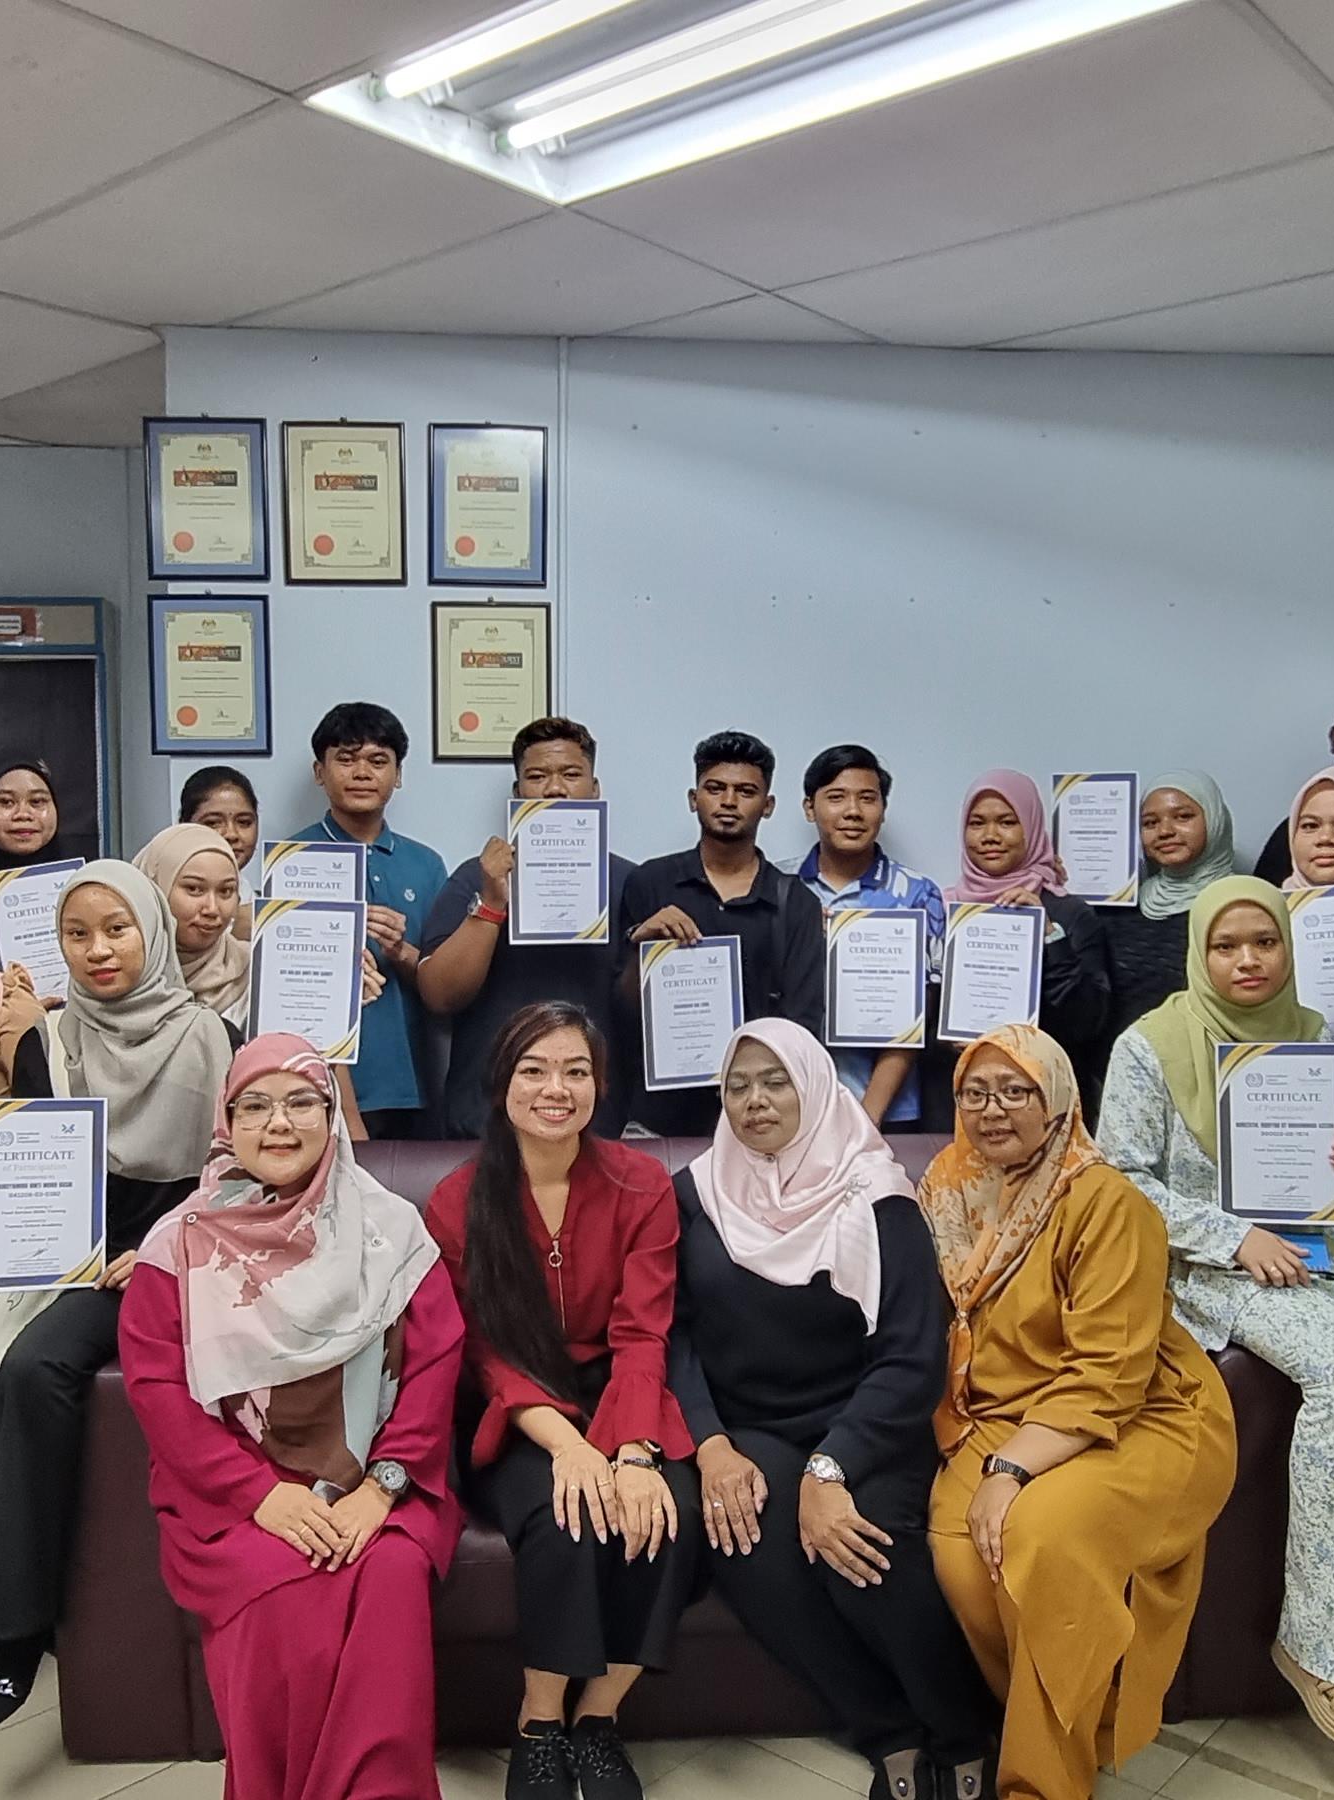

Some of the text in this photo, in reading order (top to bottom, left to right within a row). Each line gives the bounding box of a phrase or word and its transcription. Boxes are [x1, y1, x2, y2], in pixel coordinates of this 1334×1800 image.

[530, 838, 587, 847] CERTIFICATE
[284, 880, 342, 890] CERTIFICATE
[7, 904, 58, 920] CERTIFICA
[276, 942, 339, 954] CERTIFICATE
[1246, 1092, 1322, 1102] CERTIFICATE
